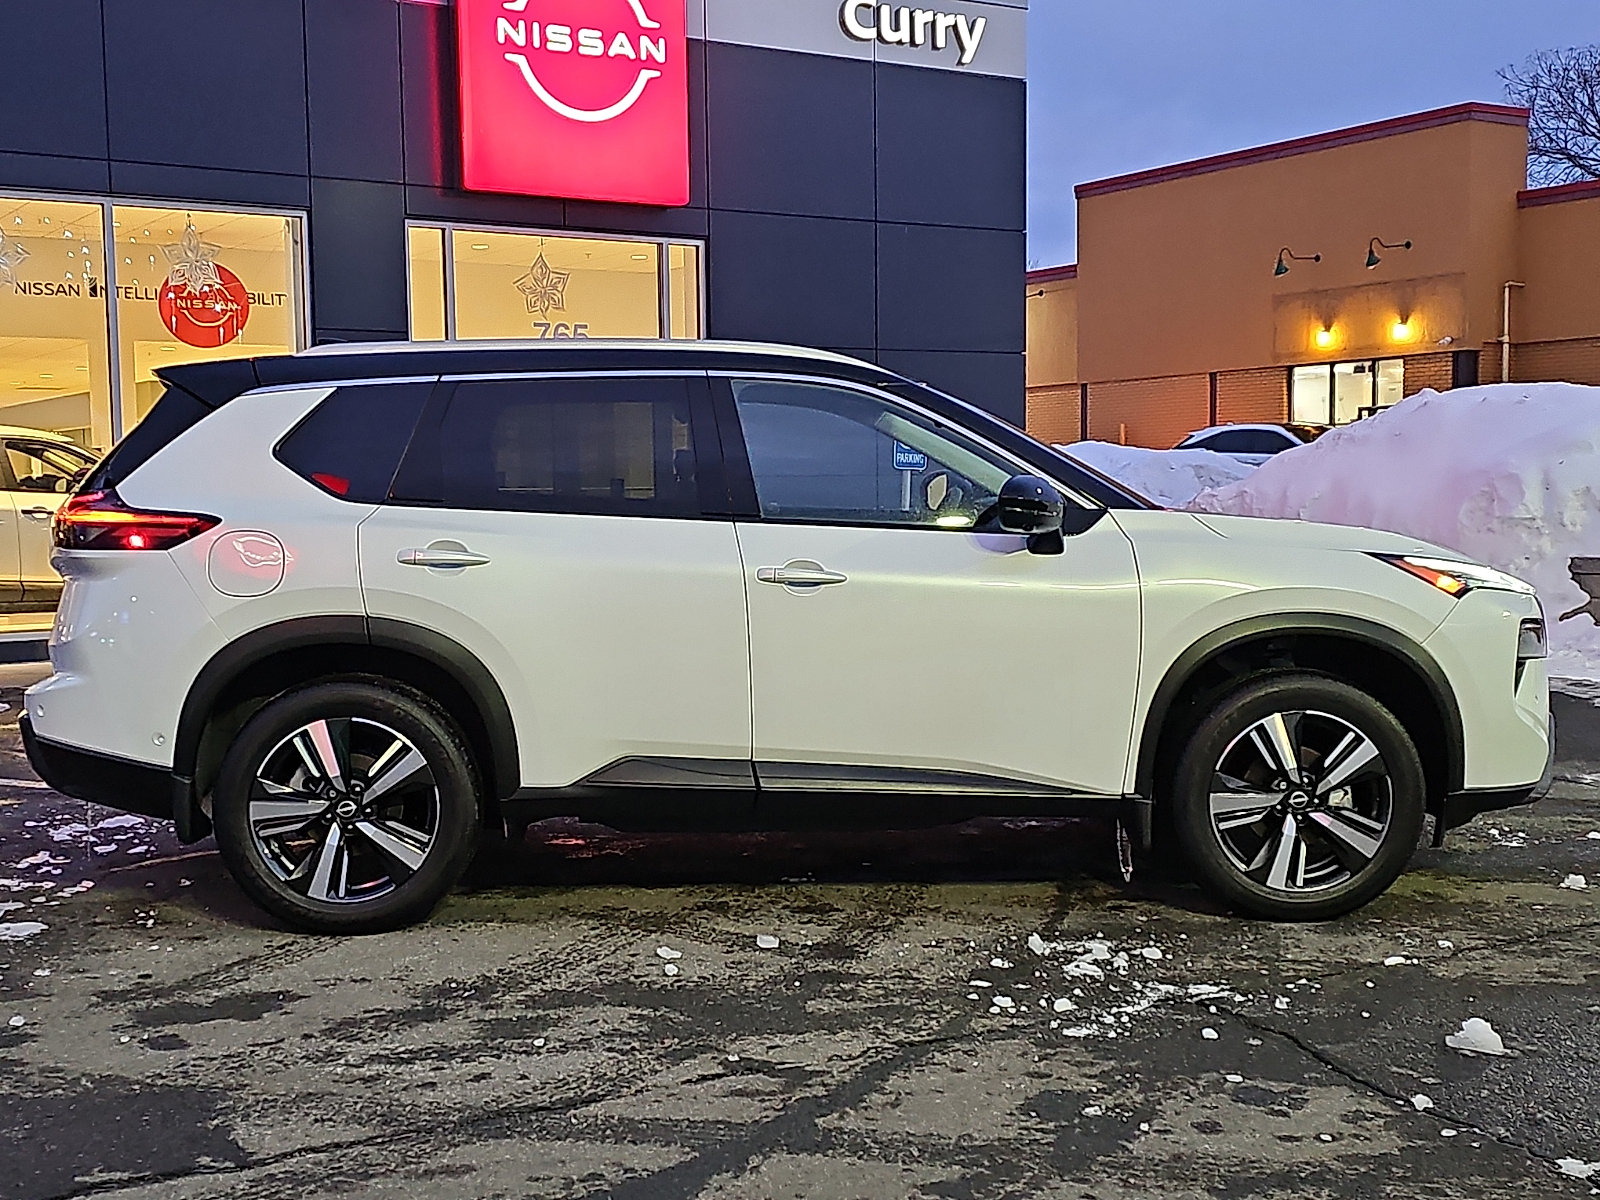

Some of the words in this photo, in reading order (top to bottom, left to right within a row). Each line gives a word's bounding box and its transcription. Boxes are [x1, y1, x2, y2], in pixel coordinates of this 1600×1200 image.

[496, 15, 667, 65] NISSAN
[839, 0, 987, 66] Curry
[15, 281, 81, 297] NISSAN
[176, 298, 238, 312] NISSAN
[533, 322, 589, 340] 765
[896, 452, 925, 464] PARKING
